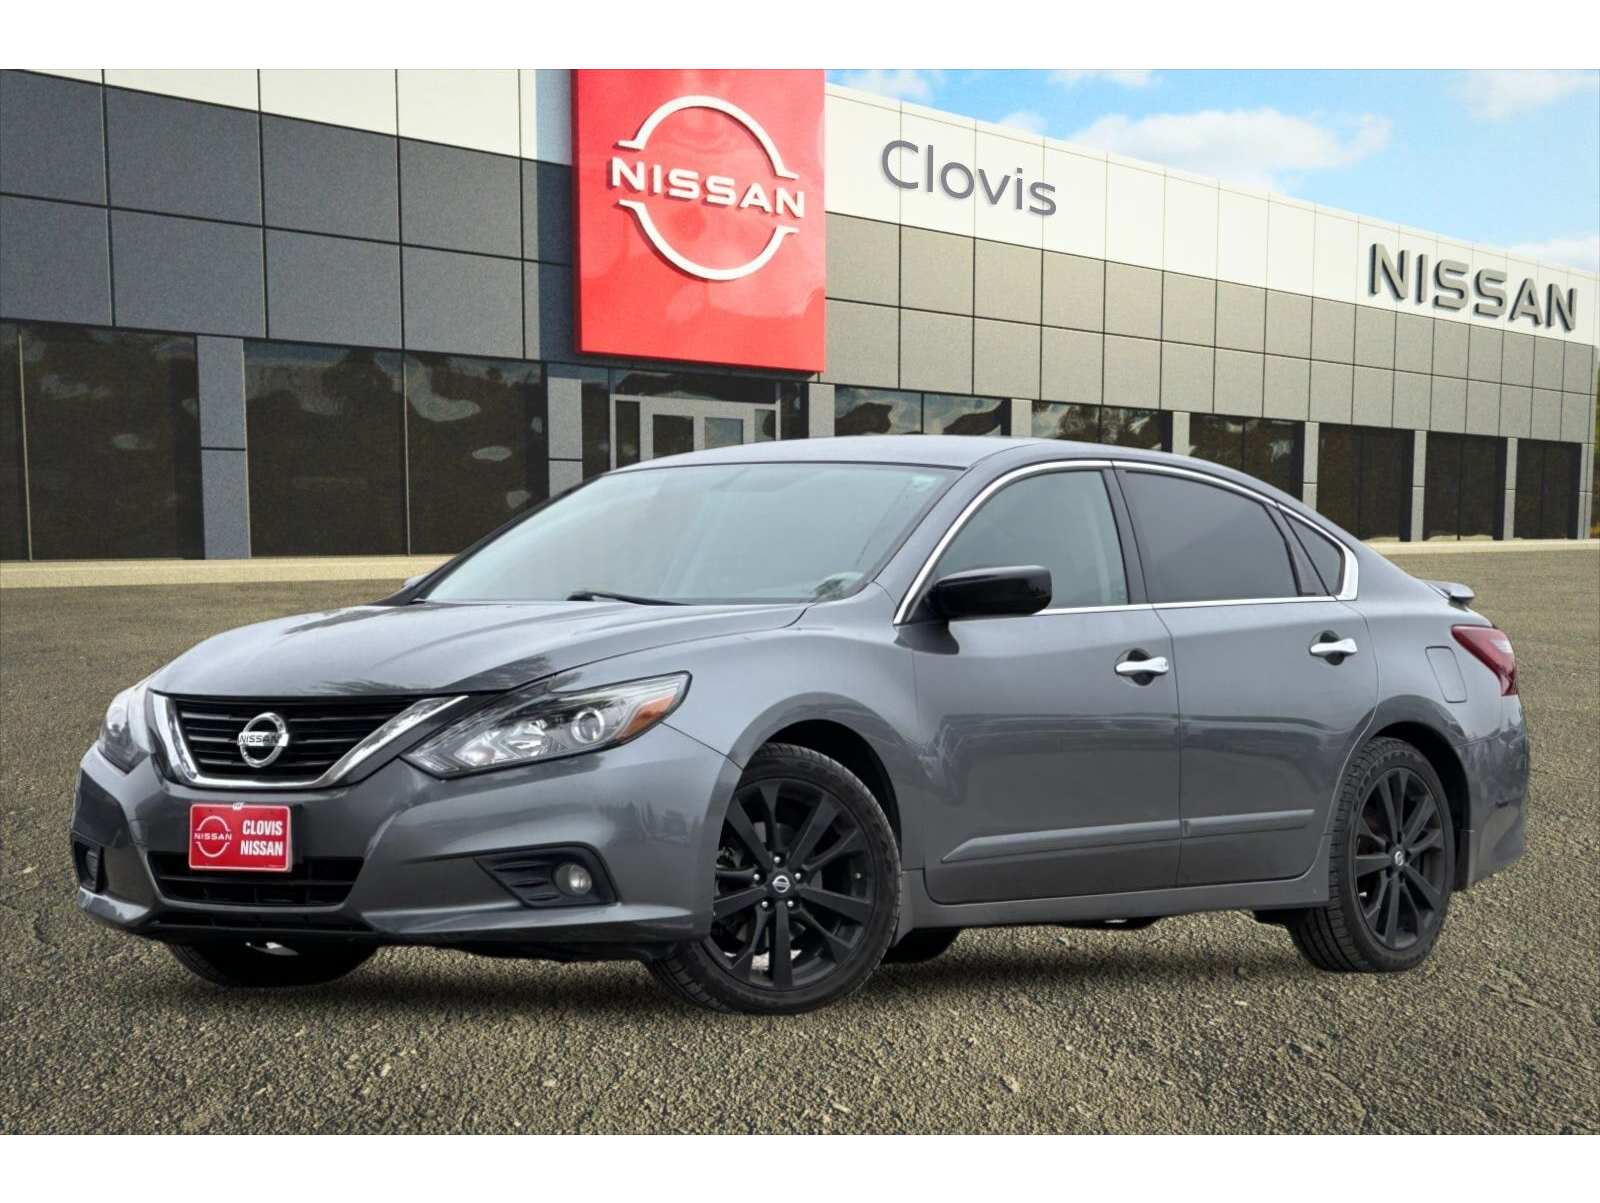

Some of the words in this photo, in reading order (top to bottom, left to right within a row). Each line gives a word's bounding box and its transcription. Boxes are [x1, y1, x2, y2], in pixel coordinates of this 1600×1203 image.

[881, 140, 1057, 216] Clovis
[611, 156, 805, 218] NISSAN
[1368, 242, 1578, 332] NISSAN
[239, 734, 281, 744] NISSAN
[194, 831, 233, 841] NISSAN
[242, 820, 283, 836] CLOVIS
[240, 840, 283, 856] NISSAN
